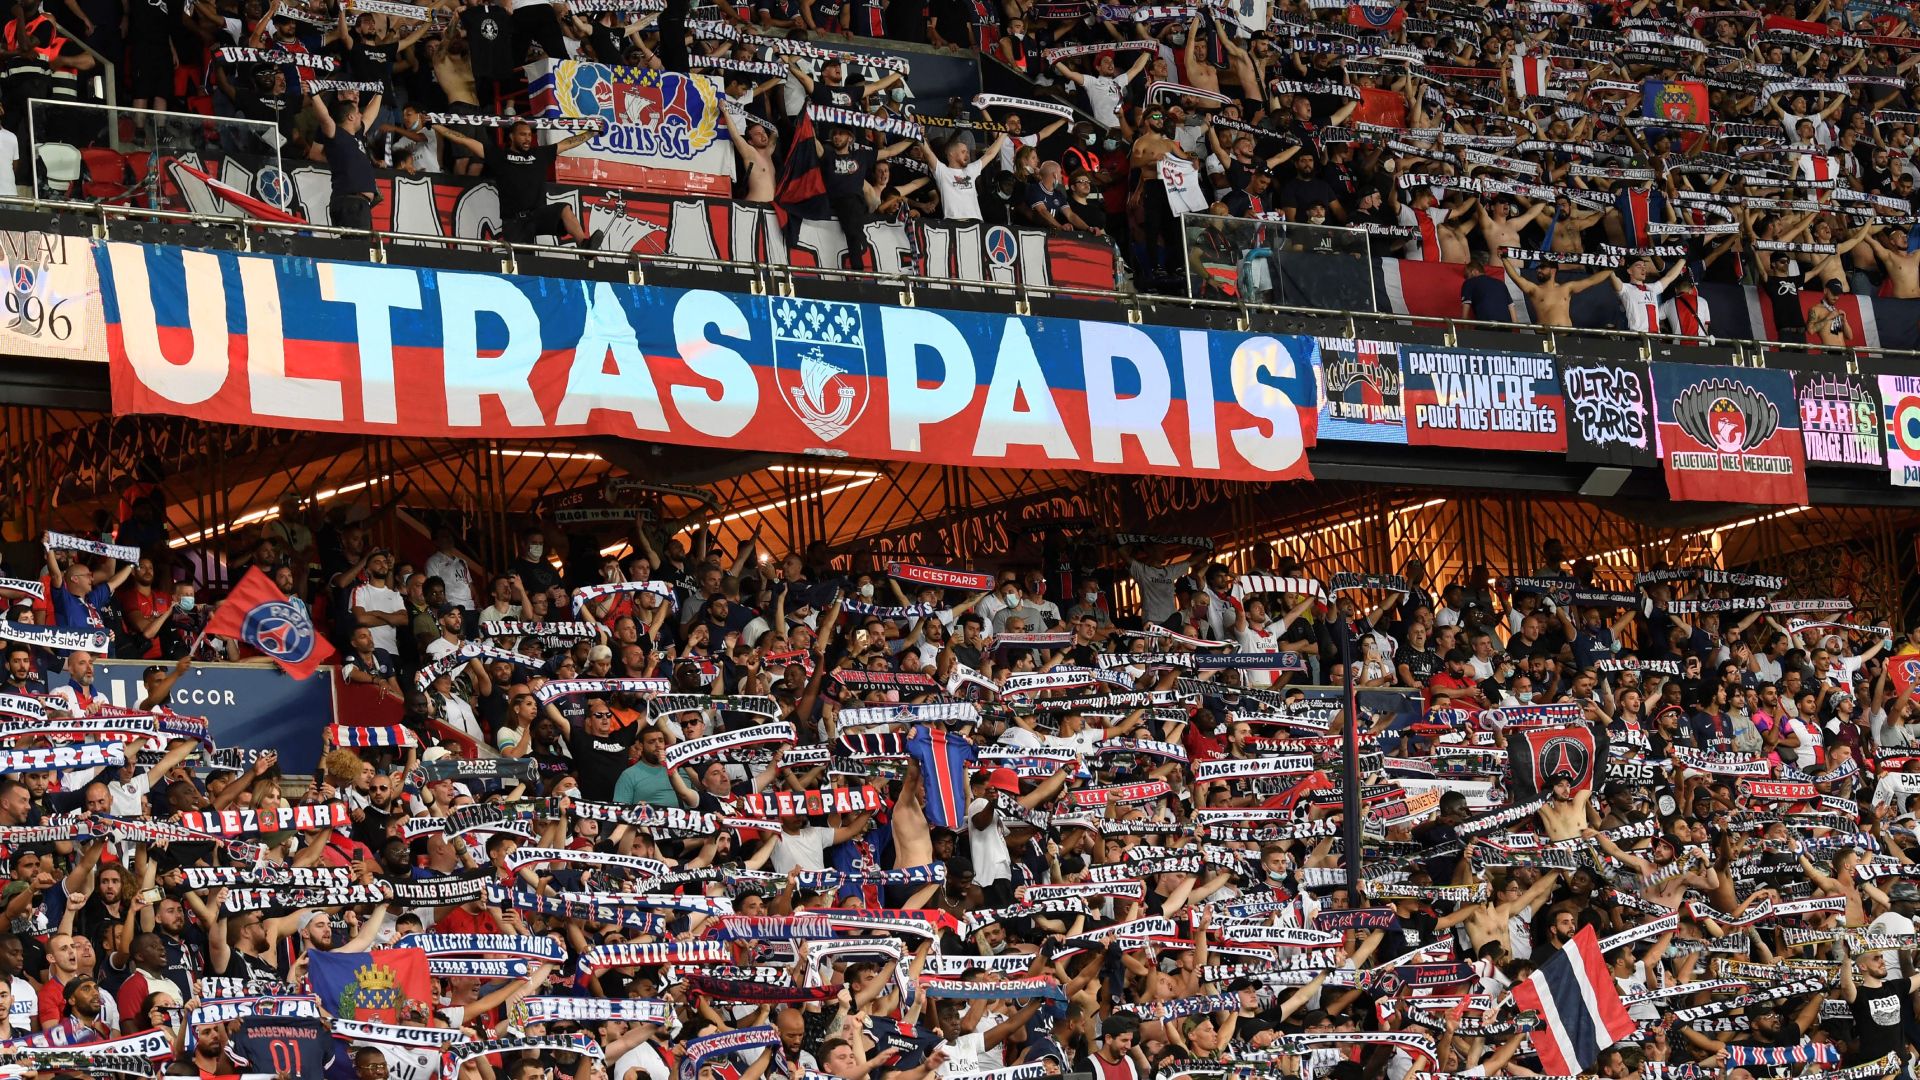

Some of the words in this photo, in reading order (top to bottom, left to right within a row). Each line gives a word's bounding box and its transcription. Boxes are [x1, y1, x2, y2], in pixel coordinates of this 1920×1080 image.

[660, 124, 690, 155] SG
[107, 242, 759, 440] ULTRAS
[880, 305, 1304, 471] PARIS
[1409, 352, 1467, 375] PARTOUT
[1470, 355, 1483, 375] ET
[1485, 355, 1553, 380] TOUJOURS
[1431, 373, 1537, 410] VAINCRE
[1567, 368, 1641, 404] ULTRAS
[1340, 402, 1369, 420] MEURT
[1416, 405, 1458, 428] POUR
[1460, 407, 1488, 431] NOS
[1491, 404, 1557, 433] LIBERTÉS
[1804, 400, 1872, 433] PARIS
[1579, 405, 1643, 440] PARIS
[1804, 432, 1842, 460] VIRAGE
[1842, 432, 1882, 465] AUTEUIL
[1672, 452, 1718, 470] FLUCTUAT
[1721, 454, 1740, 471] NEC
[1742, 455, 1792, 474] MERGITUR
[909, 568, 922, 578] ICI
[923, 570, 948, 582] C'EST
[950, 572, 978, 586] PARIS
[840, 671, 867, 682] PARIS
[868, 673, 895, 684] SAINT
[537, 681, 604, 700] ULTRAS
[620, 680, 670, 693] PARIS
[667, 738, 714, 763] FLUCTUAT
[715, 733, 738, 745] NEC
[782, 751, 827, 765] VIRAGE
[457, 759, 497, 770] PARIS
[1199, 764, 1236, 777] IRAGE
[1239, 764, 1248, 772] 19
[1274, 759, 1313, 771] AUTEUI
[1880, 760, 1901, 768] ARIS
[1755, 783, 1789, 795] ALLEZ
[1792, 784, 1815, 797] PAR
[1902, 774, 1920, 786] PAR
[182, 807, 257, 833] LLEZ
[509, 849, 561, 863] VIRAGE
[395, 882, 436, 898] ULTRAS
[1266, 928, 1284, 939] NEC
[414, 934, 473, 953] COLLECTIF
[476, 935, 517, 952] ULTRAS
[520, 936, 552, 956] PARIS
[677, 941, 732, 963] ULTRA
[952, 960, 962, 970] 19
[930, 980, 963, 991] PARIS
[964, 980, 1047, 991] SAINT-GERMAIN
[269, 1040, 302, 1078] 01
